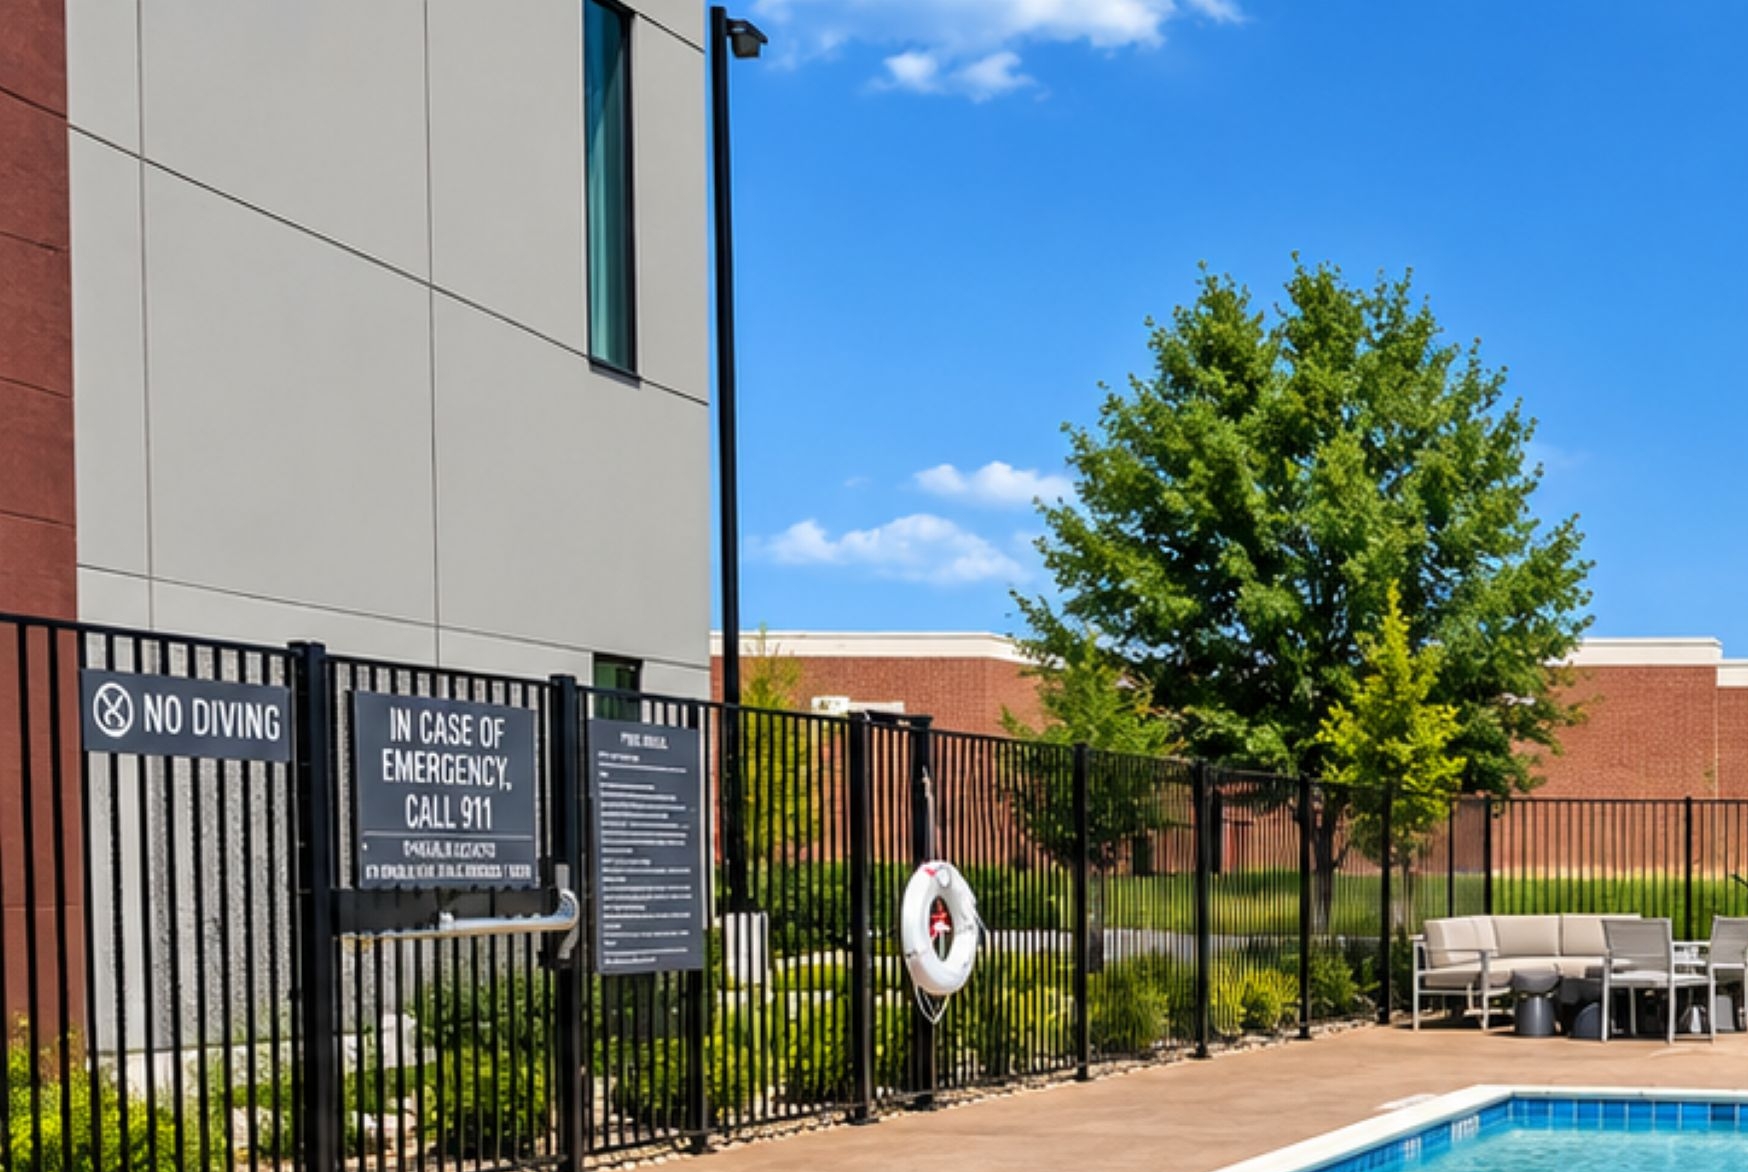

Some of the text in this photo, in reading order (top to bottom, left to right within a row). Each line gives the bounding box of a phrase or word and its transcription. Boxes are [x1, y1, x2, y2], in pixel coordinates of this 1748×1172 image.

[143, 692, 281, 742] NO DIVING
[390, 706, 505, 749] IN CASE OF
[405, 793, 492, 830] CALL 911
